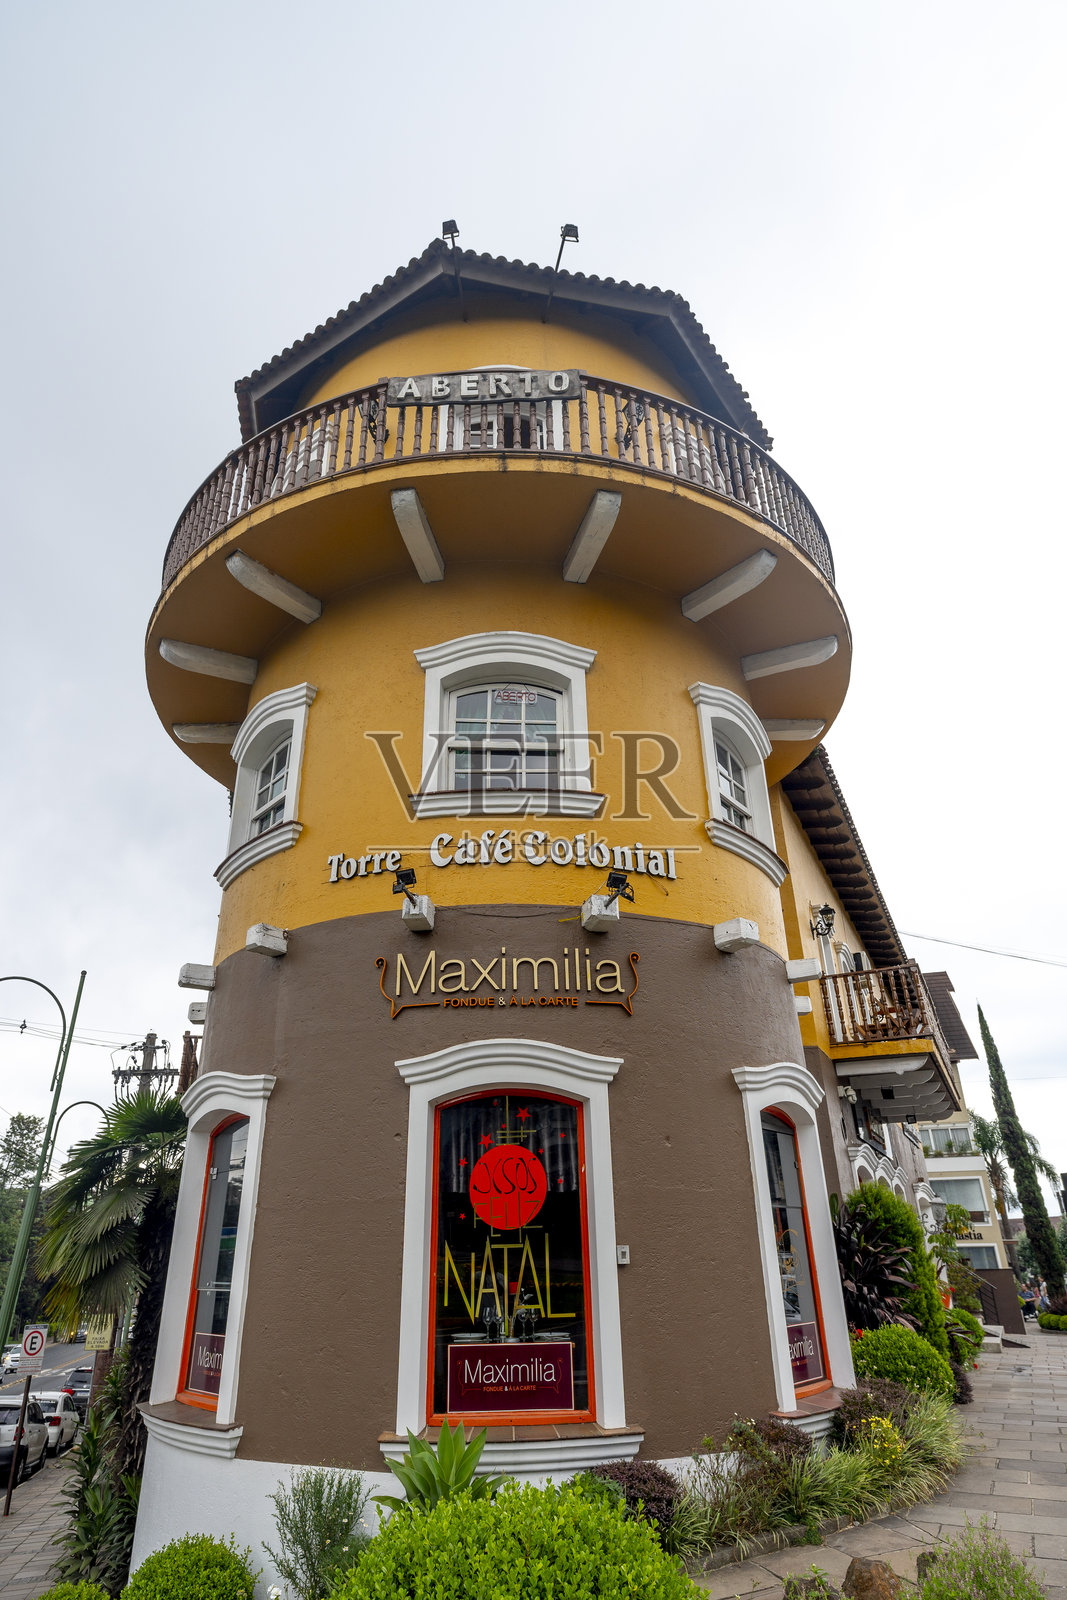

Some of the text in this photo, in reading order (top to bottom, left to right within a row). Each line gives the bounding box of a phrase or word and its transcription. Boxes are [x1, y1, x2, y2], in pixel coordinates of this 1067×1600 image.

[396, 371, 570, 400] ABERTO
[495, 690, 536, 702] ABERTO
[328, 829, 677, 883] Torre Café Colonial
[395, 947, 625, 996] Maximilia
[443, 997, 495, 1008] FONDUE
[498, 996, 506, 1006] &
[521, 996, 536, 1006] LA
[539, 996, 579, 1007] CARTE
[473, 1191, 543, 1243] FELIZ
[444, 1233, 576, 1336] NATAL
[29, 1336, 39, 1351] E
[464, 1358, 556, 1384] Maximilia
